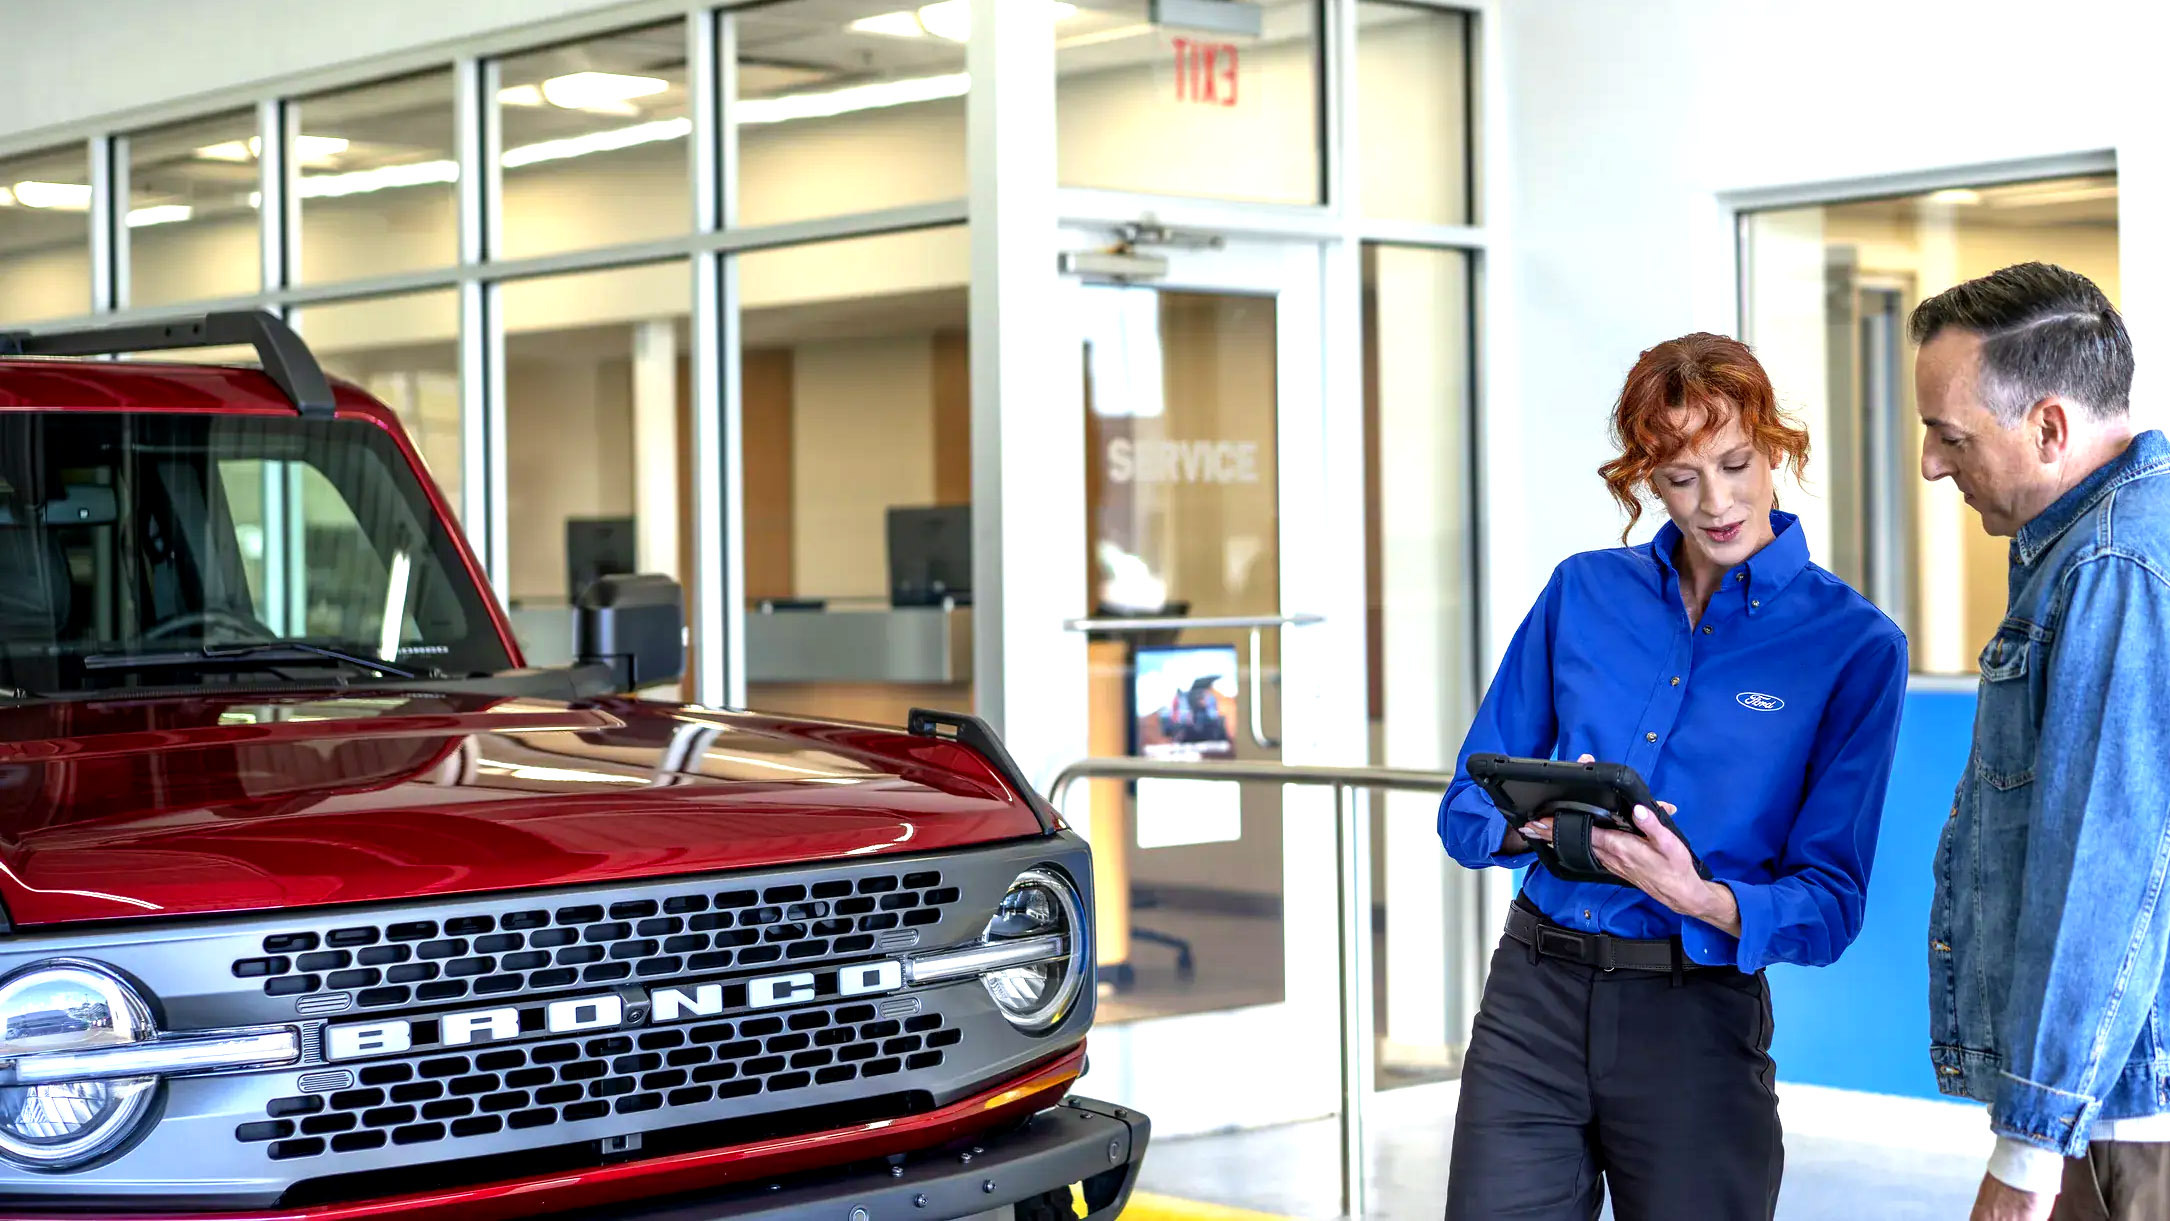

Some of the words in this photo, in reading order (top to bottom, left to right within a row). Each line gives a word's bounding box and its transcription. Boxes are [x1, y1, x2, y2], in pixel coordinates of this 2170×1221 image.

[1107, 437, 1259, 484] SERVICE
[1744, 693, 1777, 709] Ford
[326, 959, 904, 1062] BRONCO
